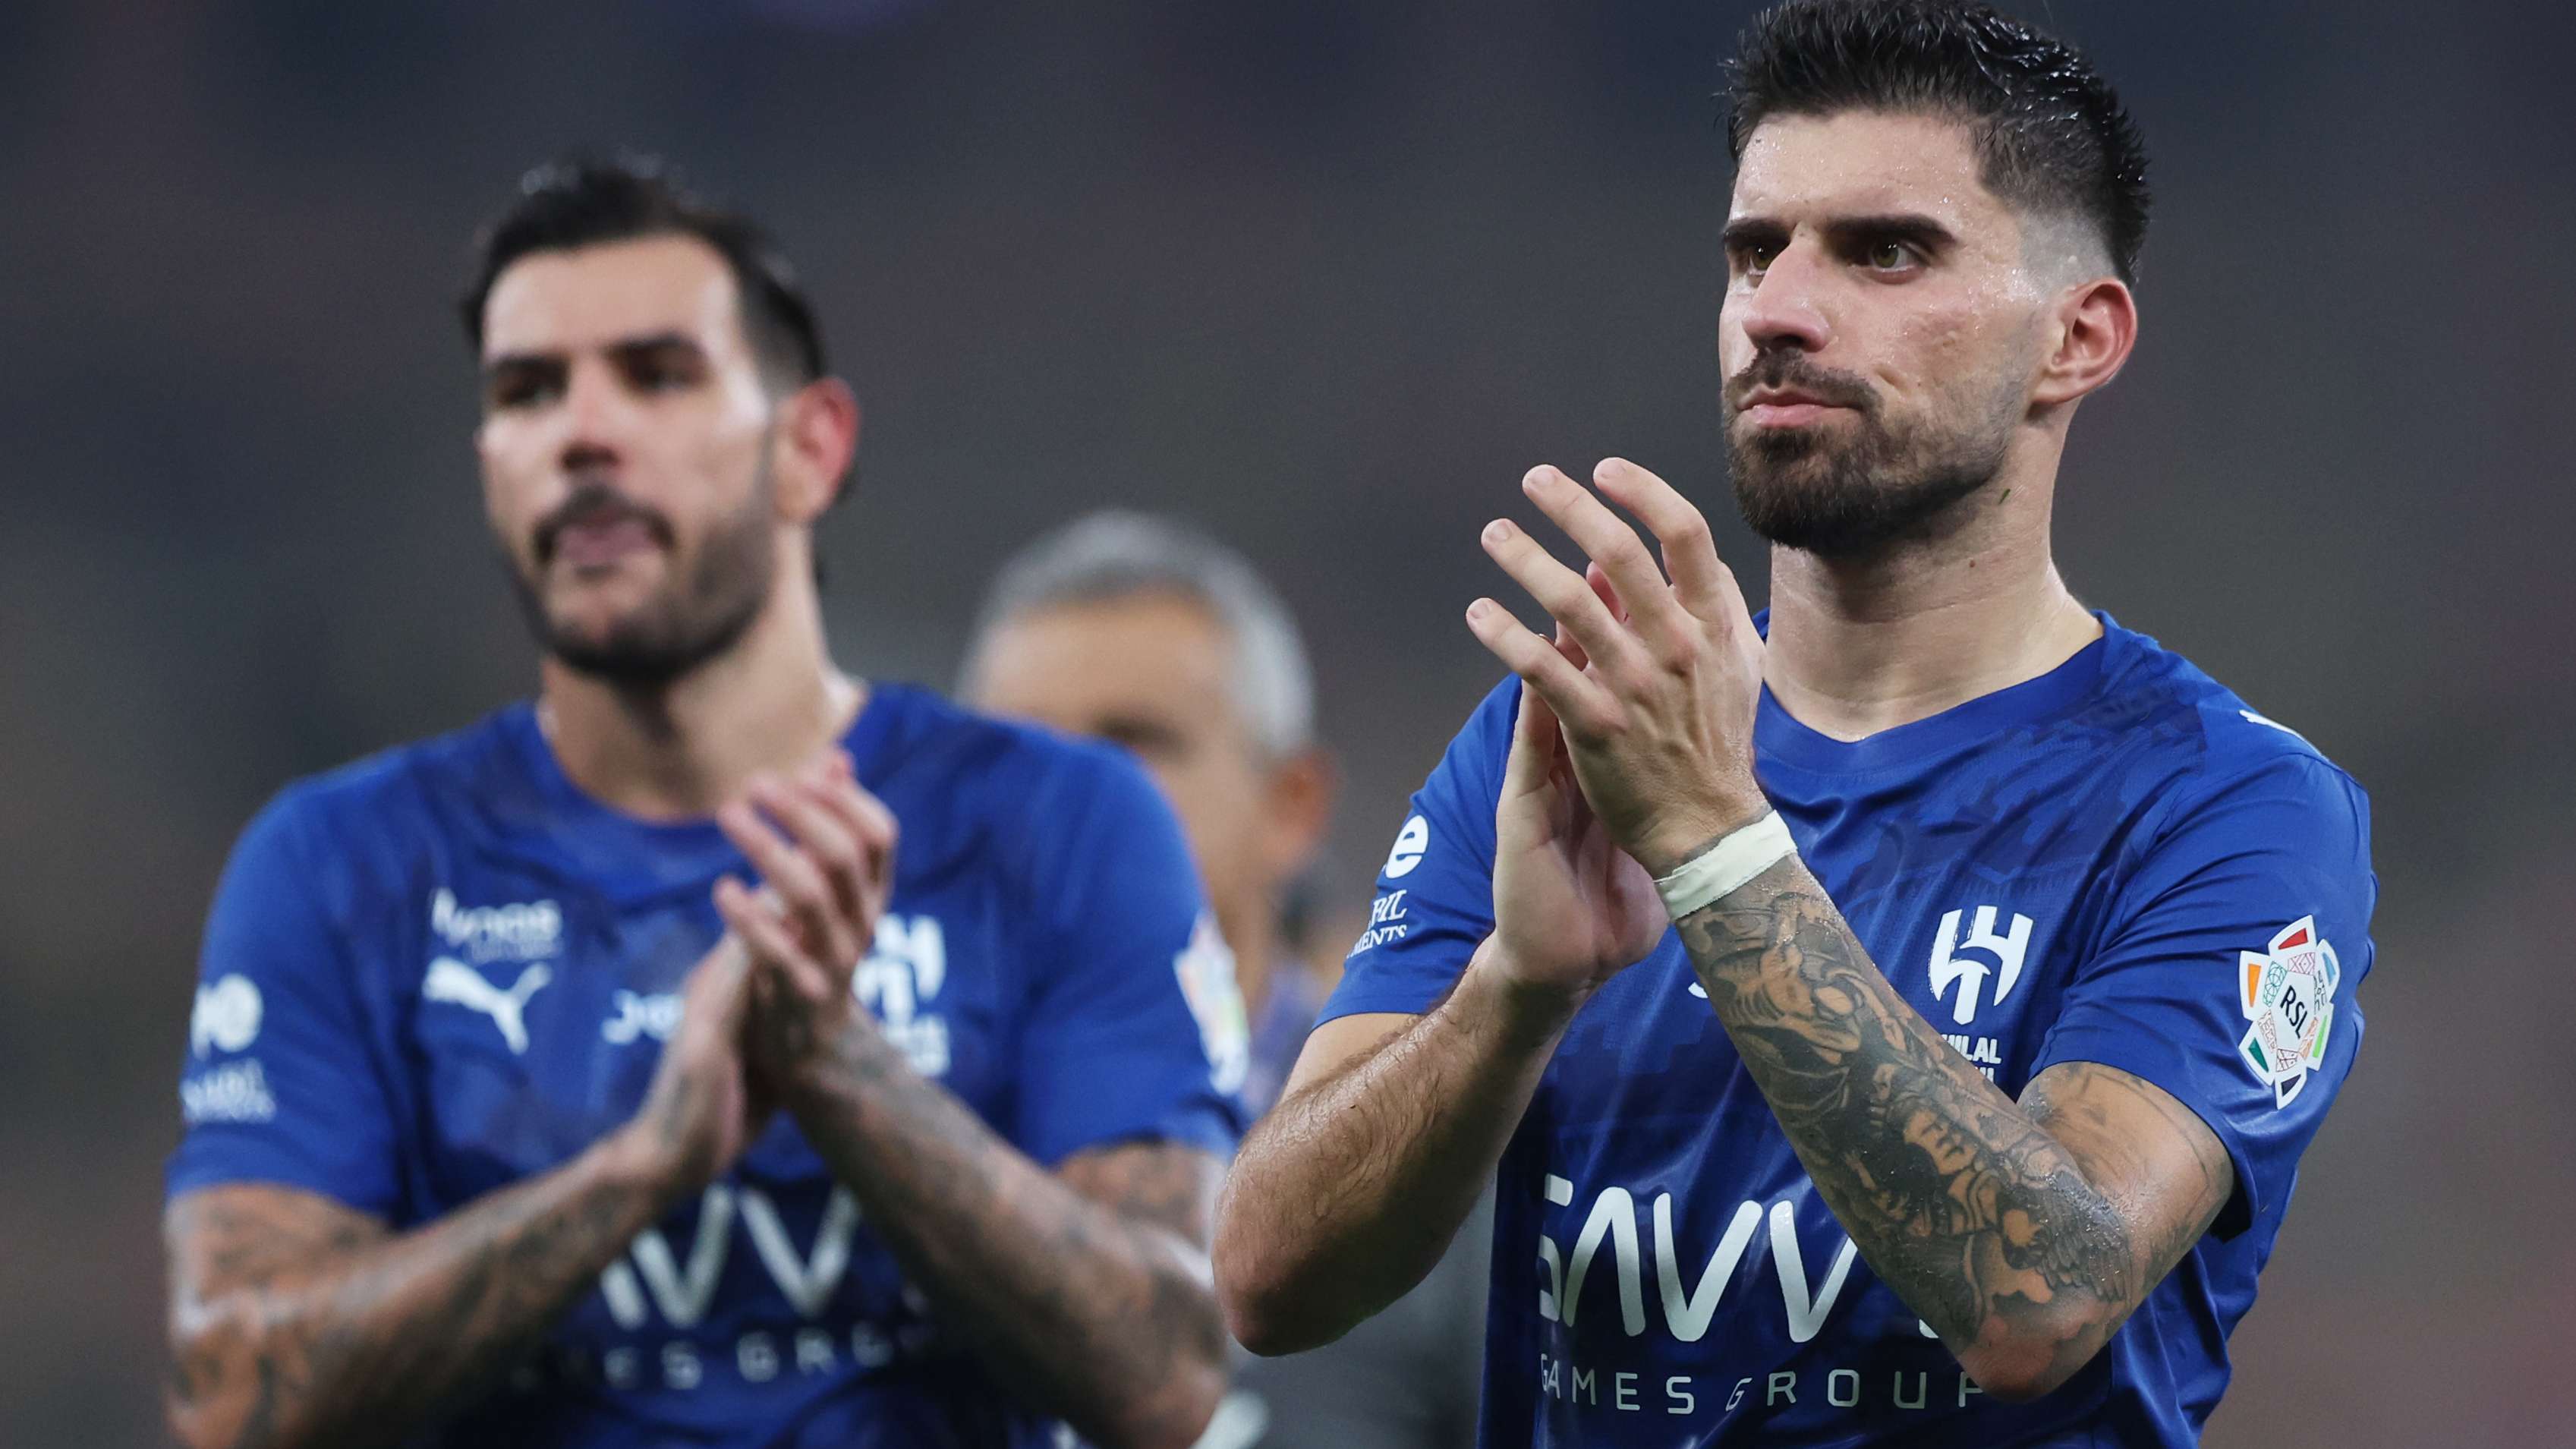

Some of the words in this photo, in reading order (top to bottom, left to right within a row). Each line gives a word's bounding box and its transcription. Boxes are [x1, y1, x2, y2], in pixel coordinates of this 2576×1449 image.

[1381, 814, 1429, 879] e
[2280, 985, 2308, 1039] RSL
[1540, 1353, 1695, 1415] GAMES
